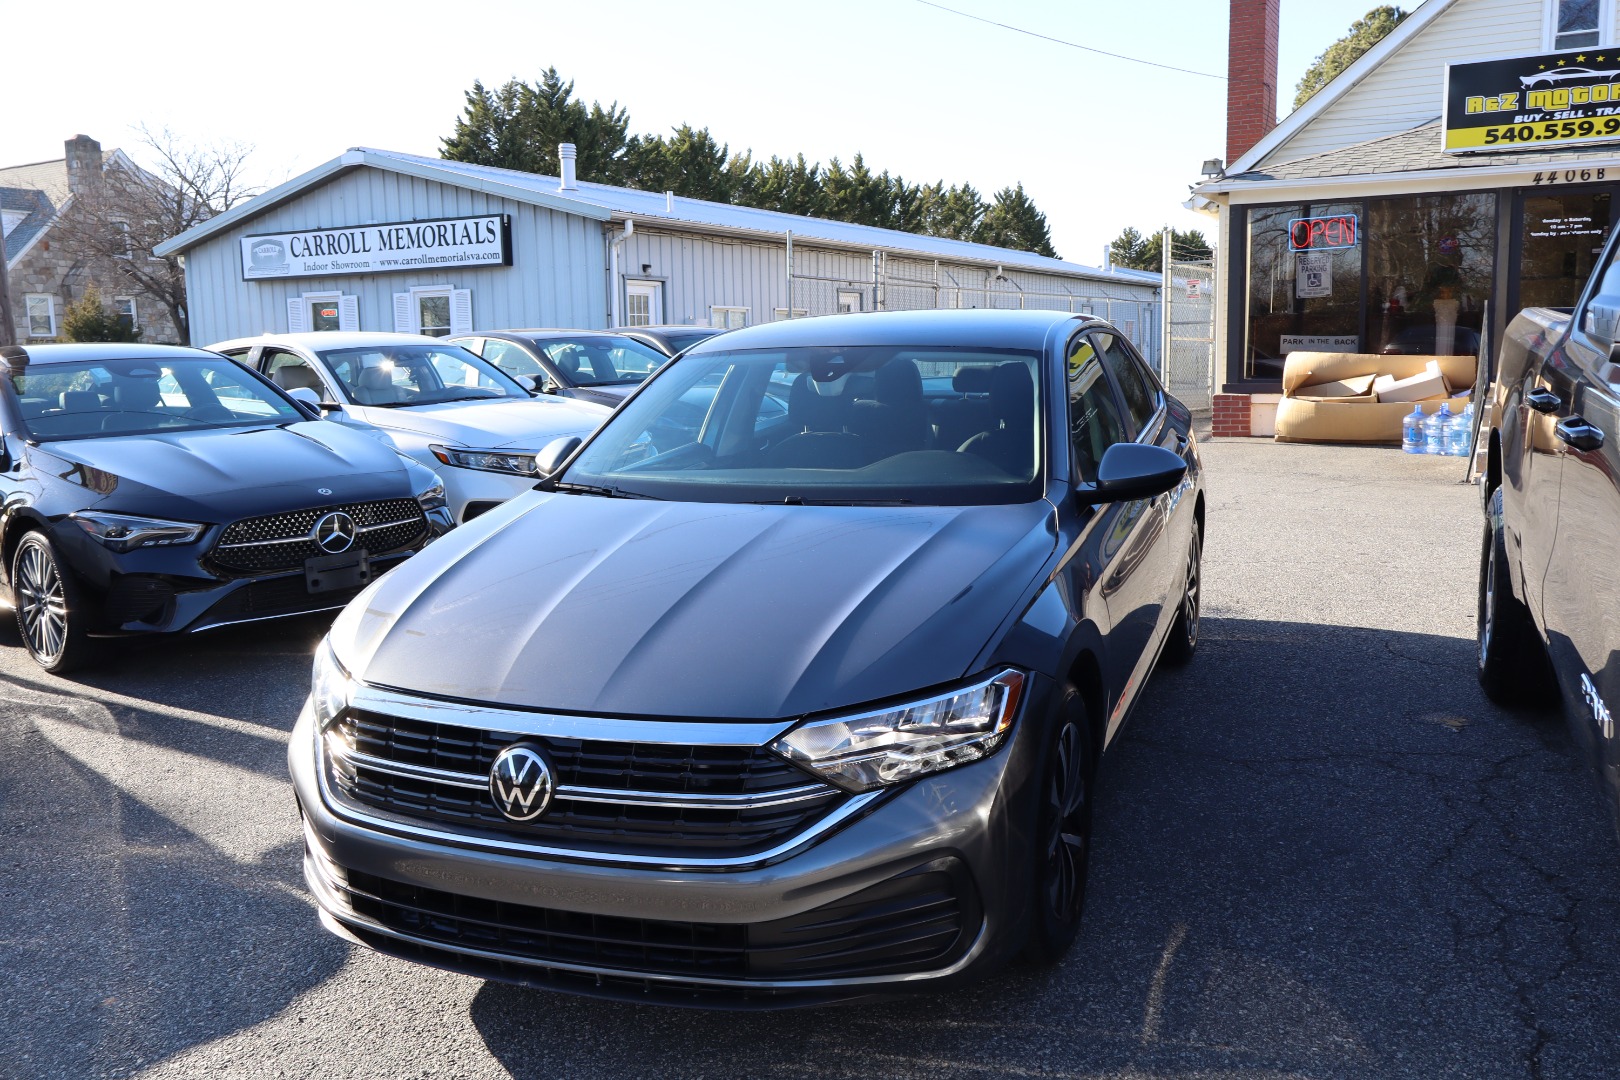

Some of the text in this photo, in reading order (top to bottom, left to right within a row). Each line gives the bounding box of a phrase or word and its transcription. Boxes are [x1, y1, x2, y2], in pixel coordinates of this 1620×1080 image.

[1513, 113, 1544, 123] BUY
[1553, 109, 1584, 119] SELL
[1484, 118, 1620, 144] 540.559.9
[290, 220, 496, 258] CARROLL MEMORIALS
[1292, 217, 1354, 248] OPEN
[303, 261, 328, 271] Indoor
[331, 260, 370, 270] Showroom
[380, 251, 500, 266] www.carrollmemorialsva.com
[1299, 256, 1329, 265] RESERVED
[1301, 265, 1327, 273] PARKING
